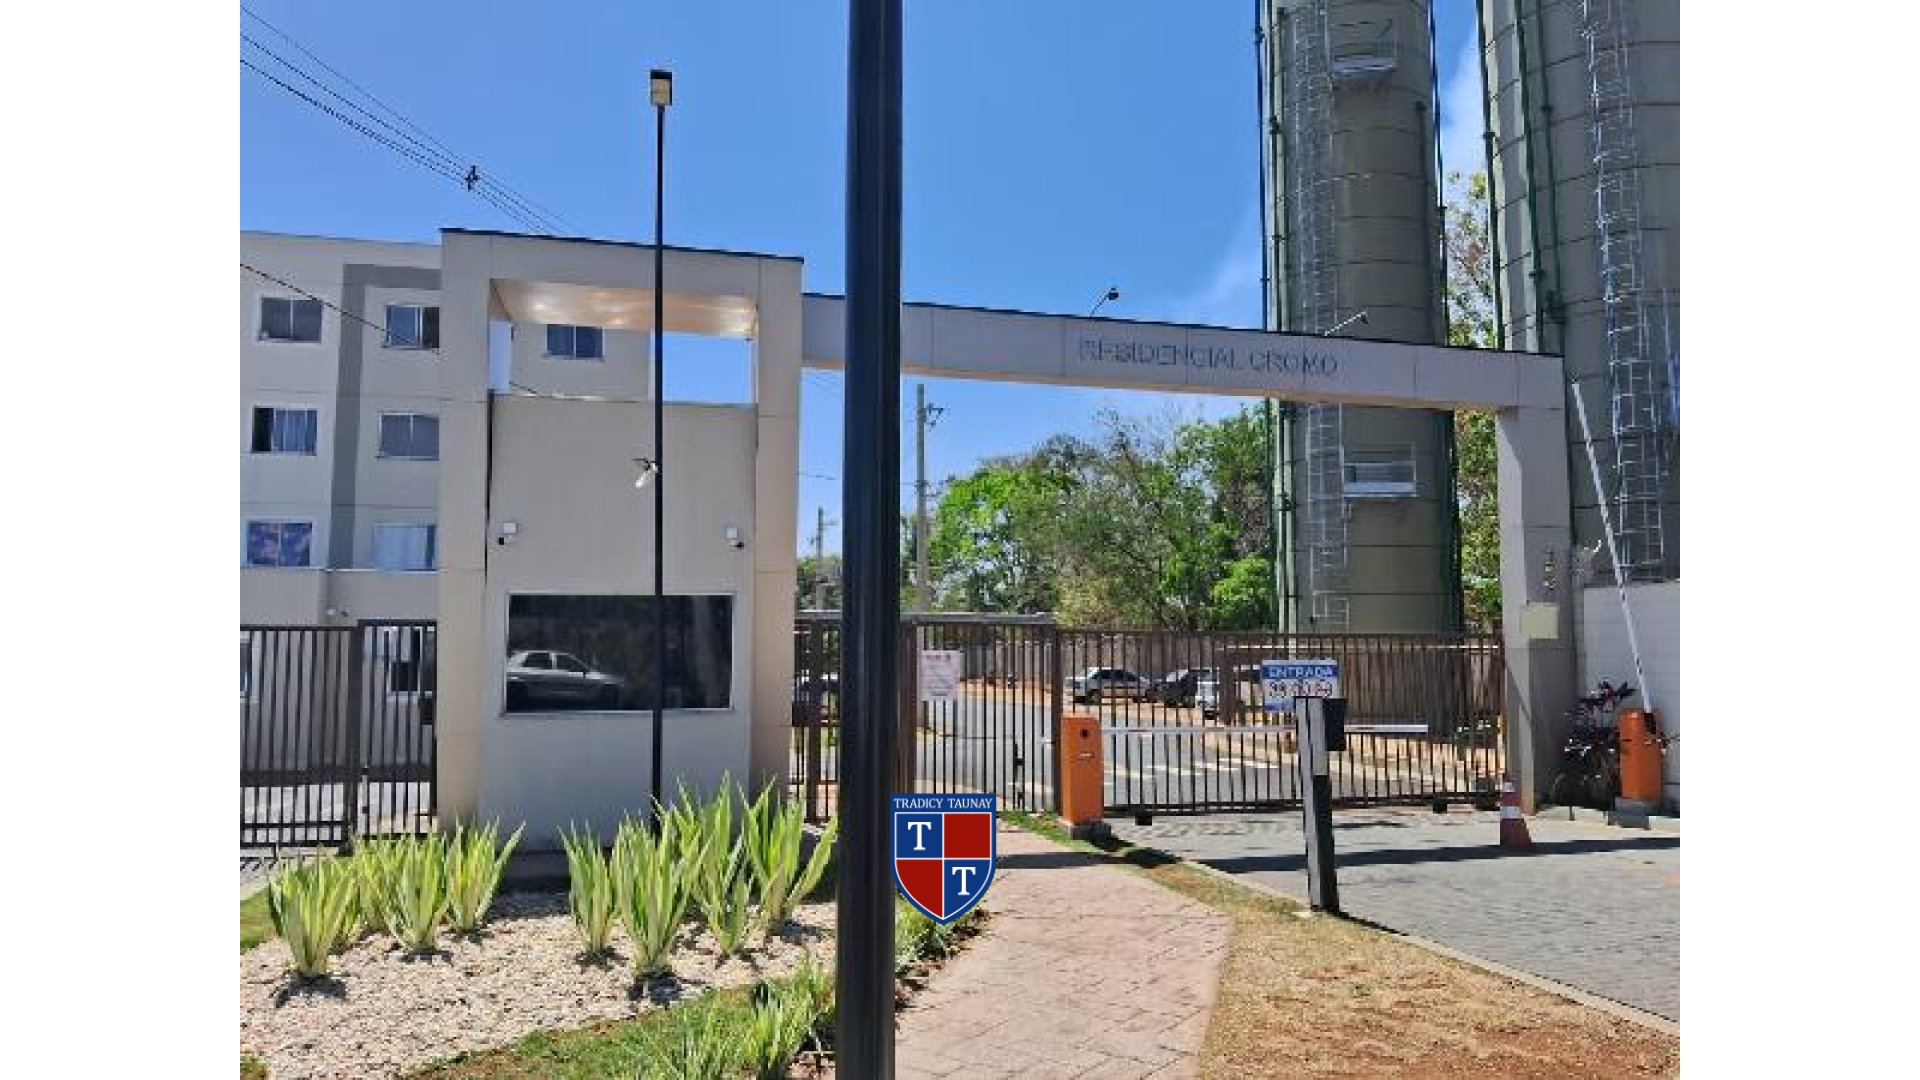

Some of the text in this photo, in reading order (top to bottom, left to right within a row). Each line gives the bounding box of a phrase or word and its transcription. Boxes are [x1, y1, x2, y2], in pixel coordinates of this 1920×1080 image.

[1079, 339, 1338, 376] RESIDENCIAL CROMO
[1268, 666, 1333, 678] ENTRADA
